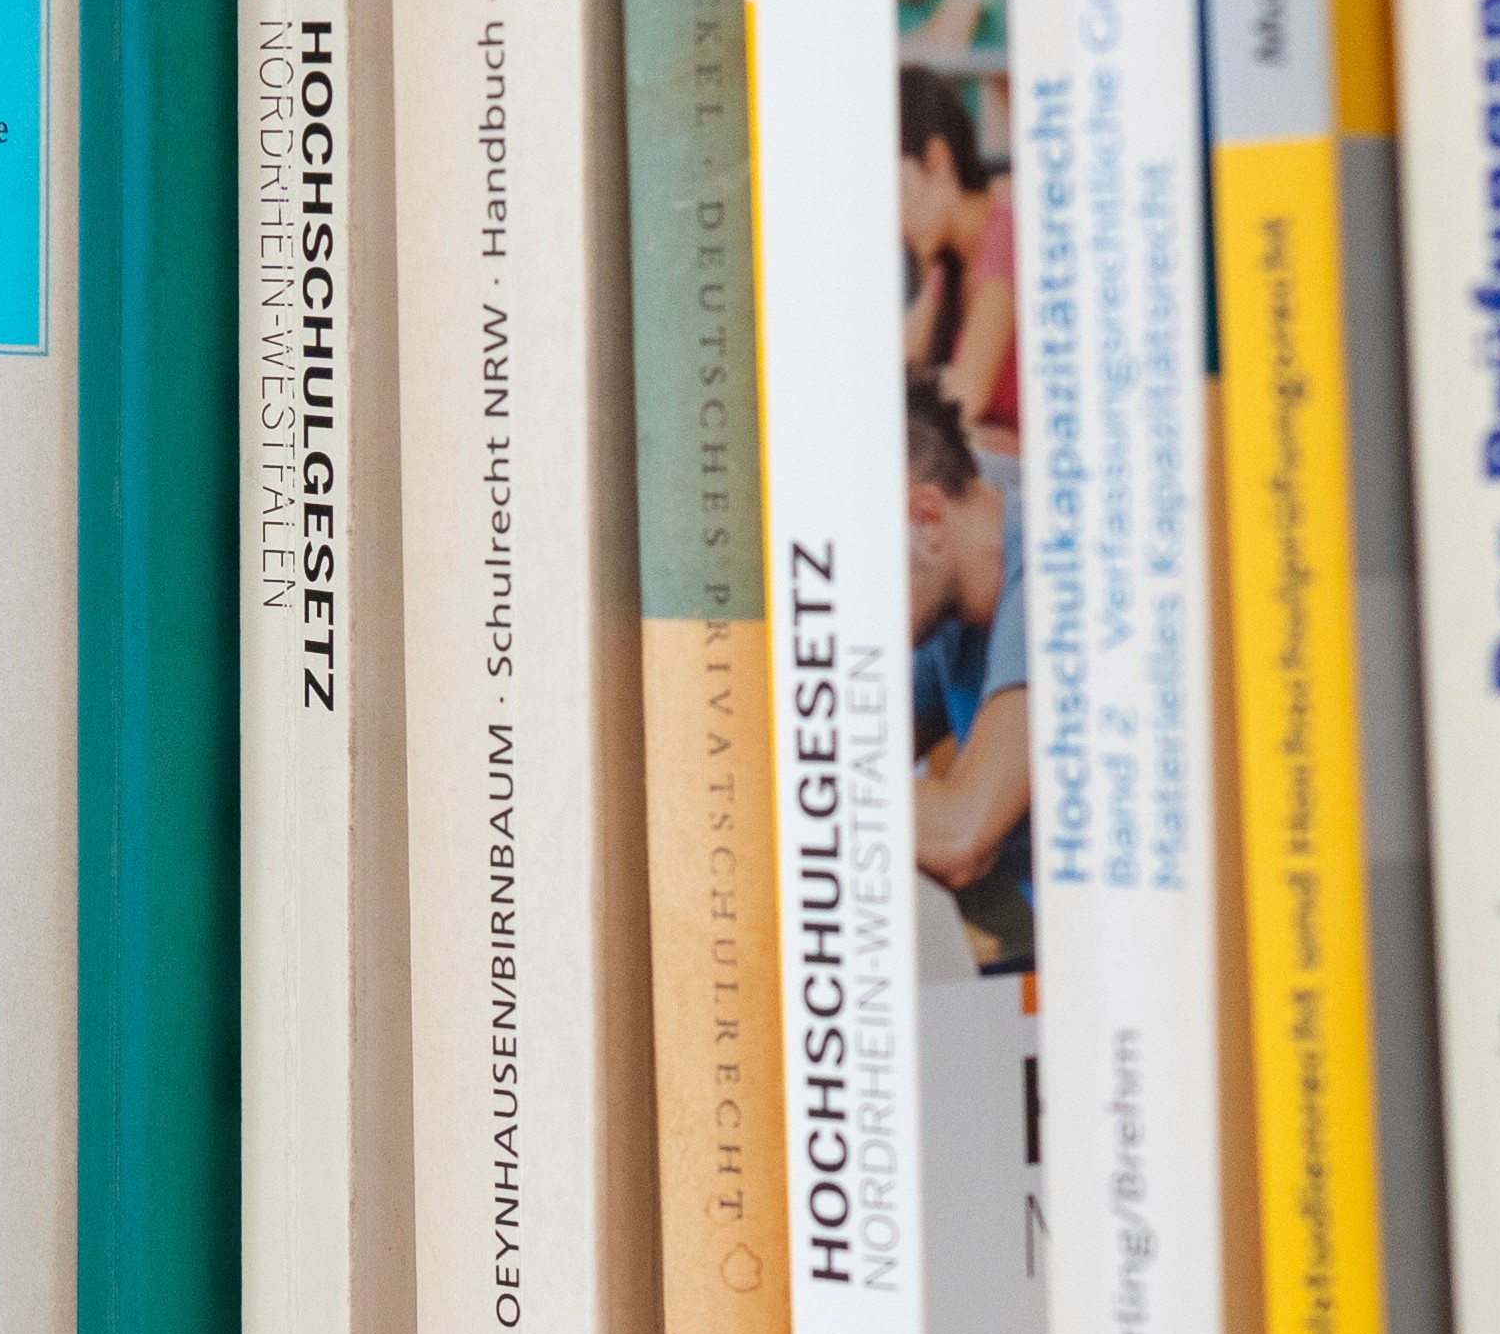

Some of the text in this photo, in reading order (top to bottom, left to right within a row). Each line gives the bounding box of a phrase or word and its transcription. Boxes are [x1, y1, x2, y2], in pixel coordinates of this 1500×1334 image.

[258, 21, 297, 609] NORDRHEIN-WESTFALEN
[301, 21, 335, 712] HOCHSCHULGESETZ
[477, 21, 508, 259] Handbuch
[482, 303, 510, 419] NRW
[695, 197, 730, 563] DEUTSCHES
[1088, 69, 1134, 651] Verfassungsrechtliche
[482, 435, 513, 677] Schulrecht
[1032, 76, 1090, 885] Hochschulkapazitätsrecht
[487, 723, 521, 1328] OEYNHAUSEN/BIRNBAUM
[702, 582, 744, 1221] PRIVATSCHULRECHT
[791, 539, 852, 1284] HOCHSCHULGESETZ
[845, 644, 899, 1292] NORDRHEIN-WESTFALEN
[1104, 752, 1140, 888] Band
